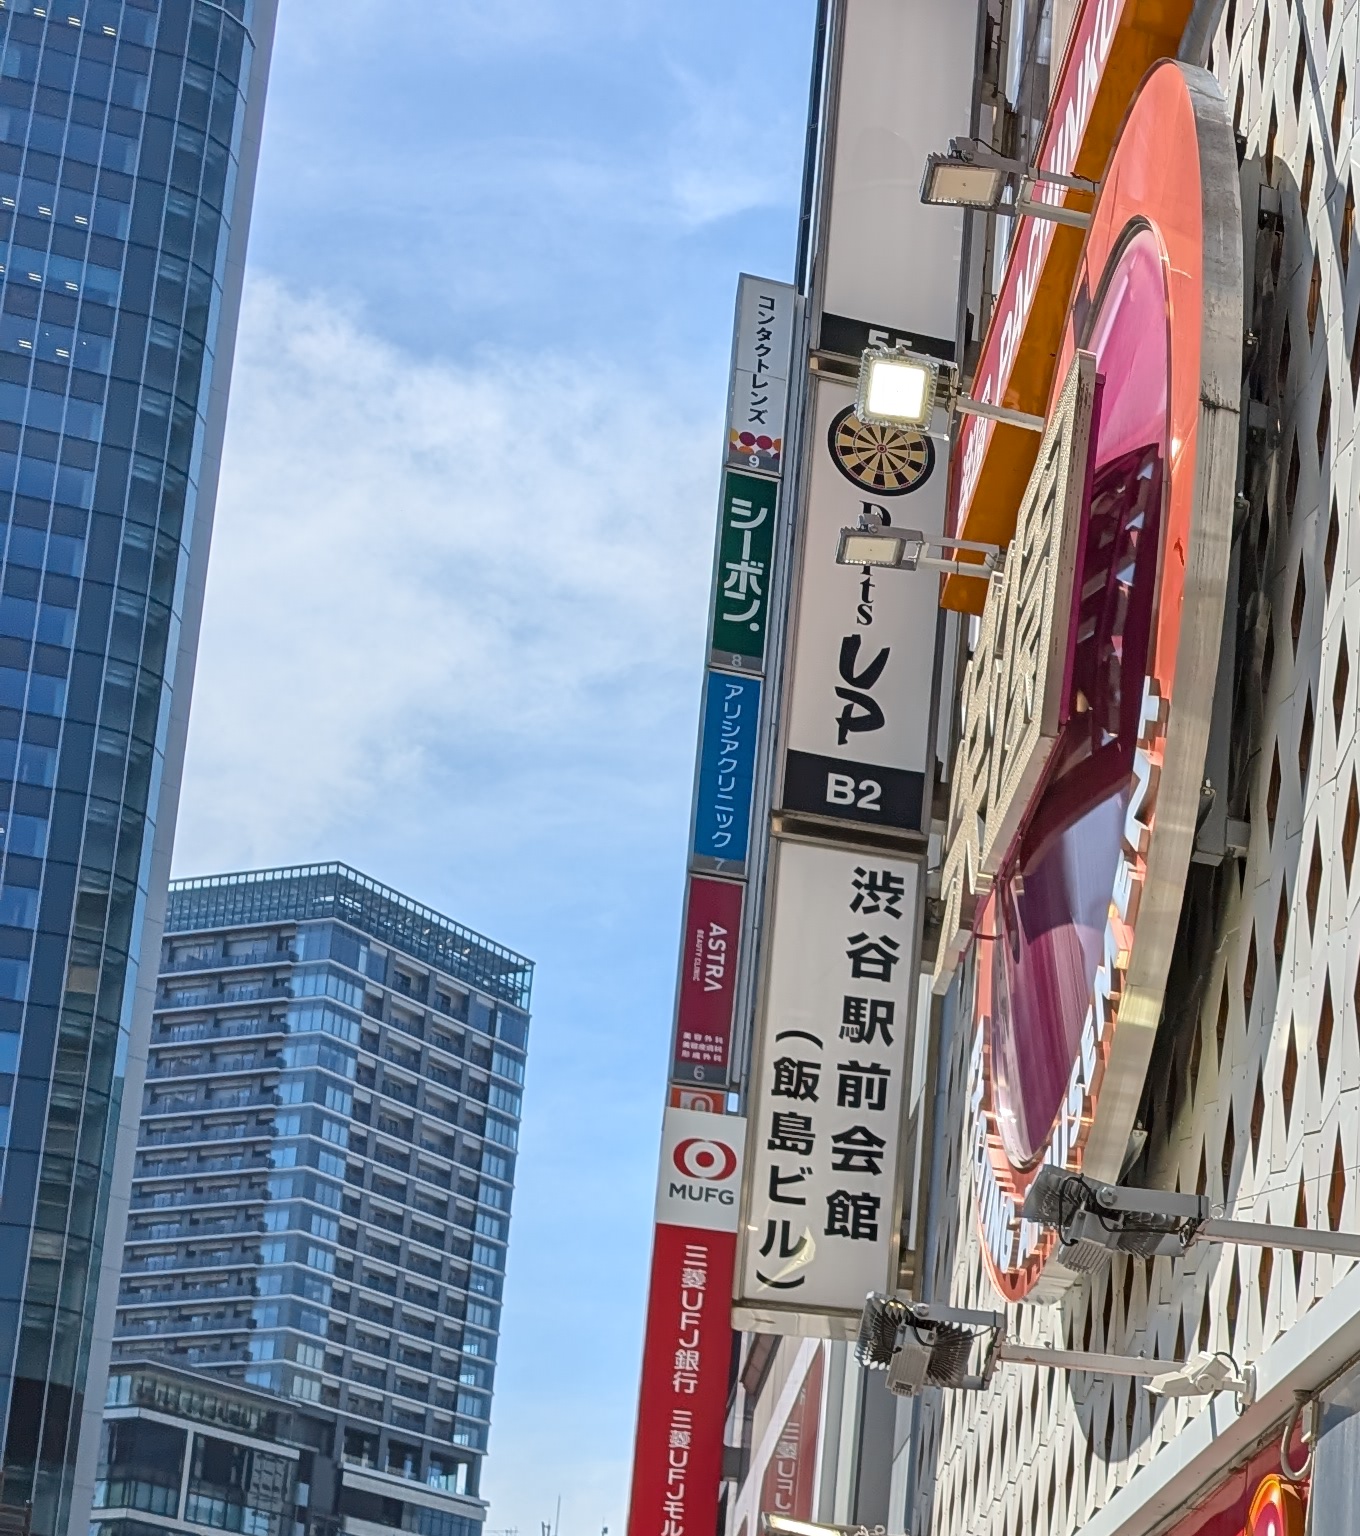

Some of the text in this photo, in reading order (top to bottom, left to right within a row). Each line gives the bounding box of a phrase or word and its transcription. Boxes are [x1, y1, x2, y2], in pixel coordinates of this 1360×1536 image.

[747, 294, 776, 425] コンタクトレンズ
[748, 455, 760, 469] 9
[730, 653, 743, 668] 8
[710, 682, 745, 848] アリシアクリニック
[825, 773, 883, 812] B2
[704, 921, 728, 993] ASTRA
[693, 1065, 706, 1081] 6
[822, 866, 905, 1243] 渋谷駅前会館
[668, 1182, 735, 1207] MUFG
[671, 1243, 709, 1395] 三菱UFJ銀行
